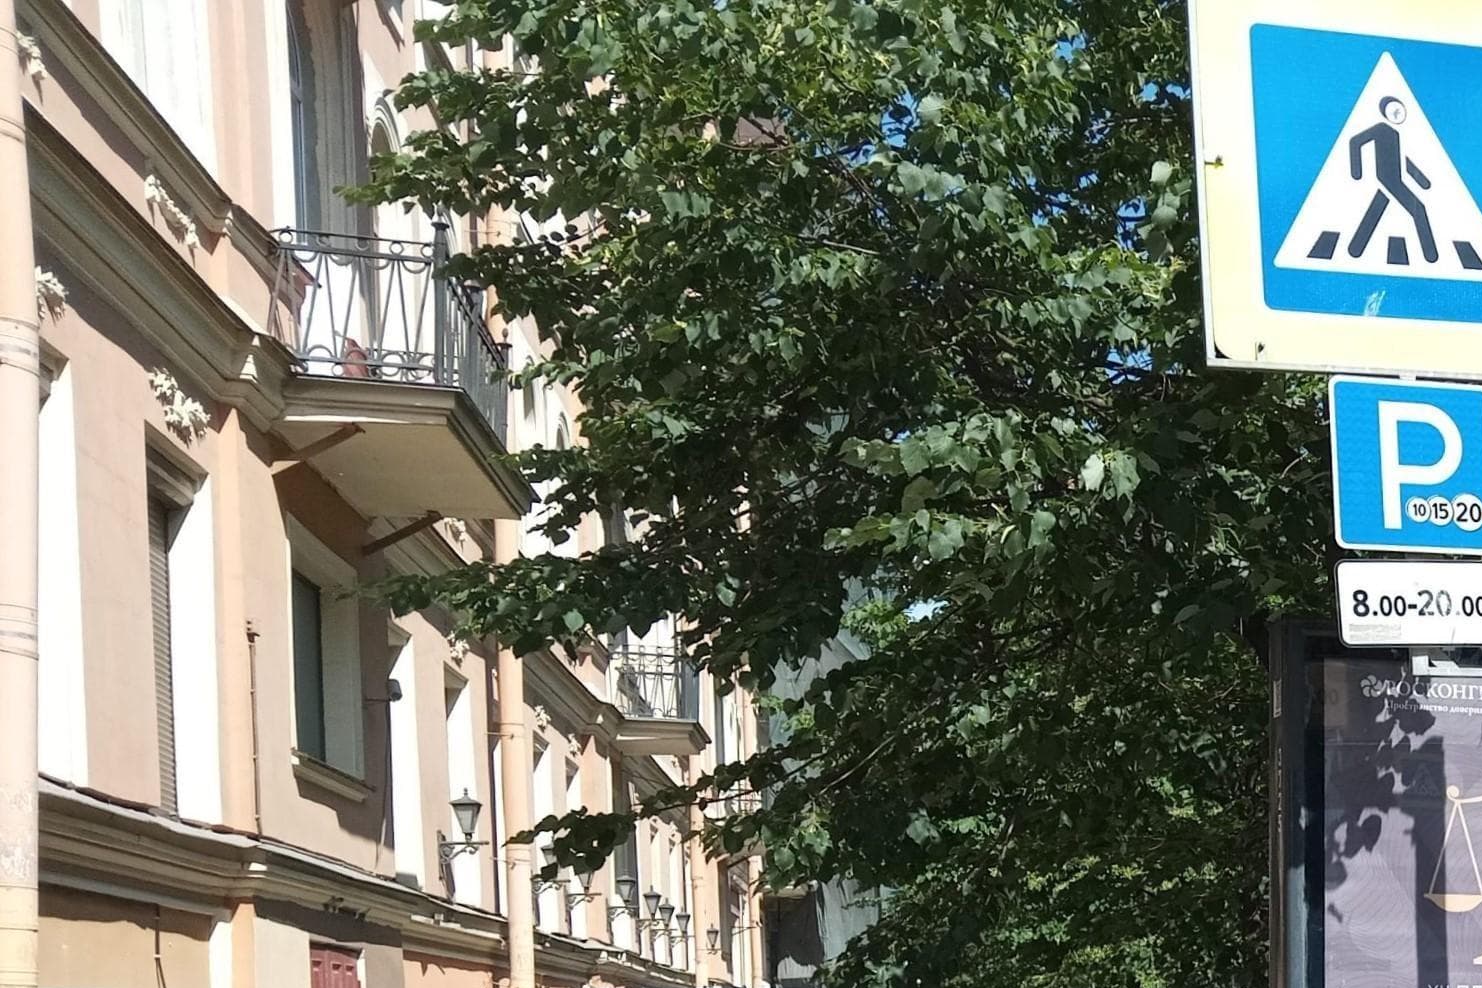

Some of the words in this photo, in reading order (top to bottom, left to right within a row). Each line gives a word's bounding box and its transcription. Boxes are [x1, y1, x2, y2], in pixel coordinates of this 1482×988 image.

[1378, 400, 1463, 529] P
[1413, 503, 1426, 516] 10
[1432, 502, 1449, 519] 15
[1456, 503, 1482, 522] 20
